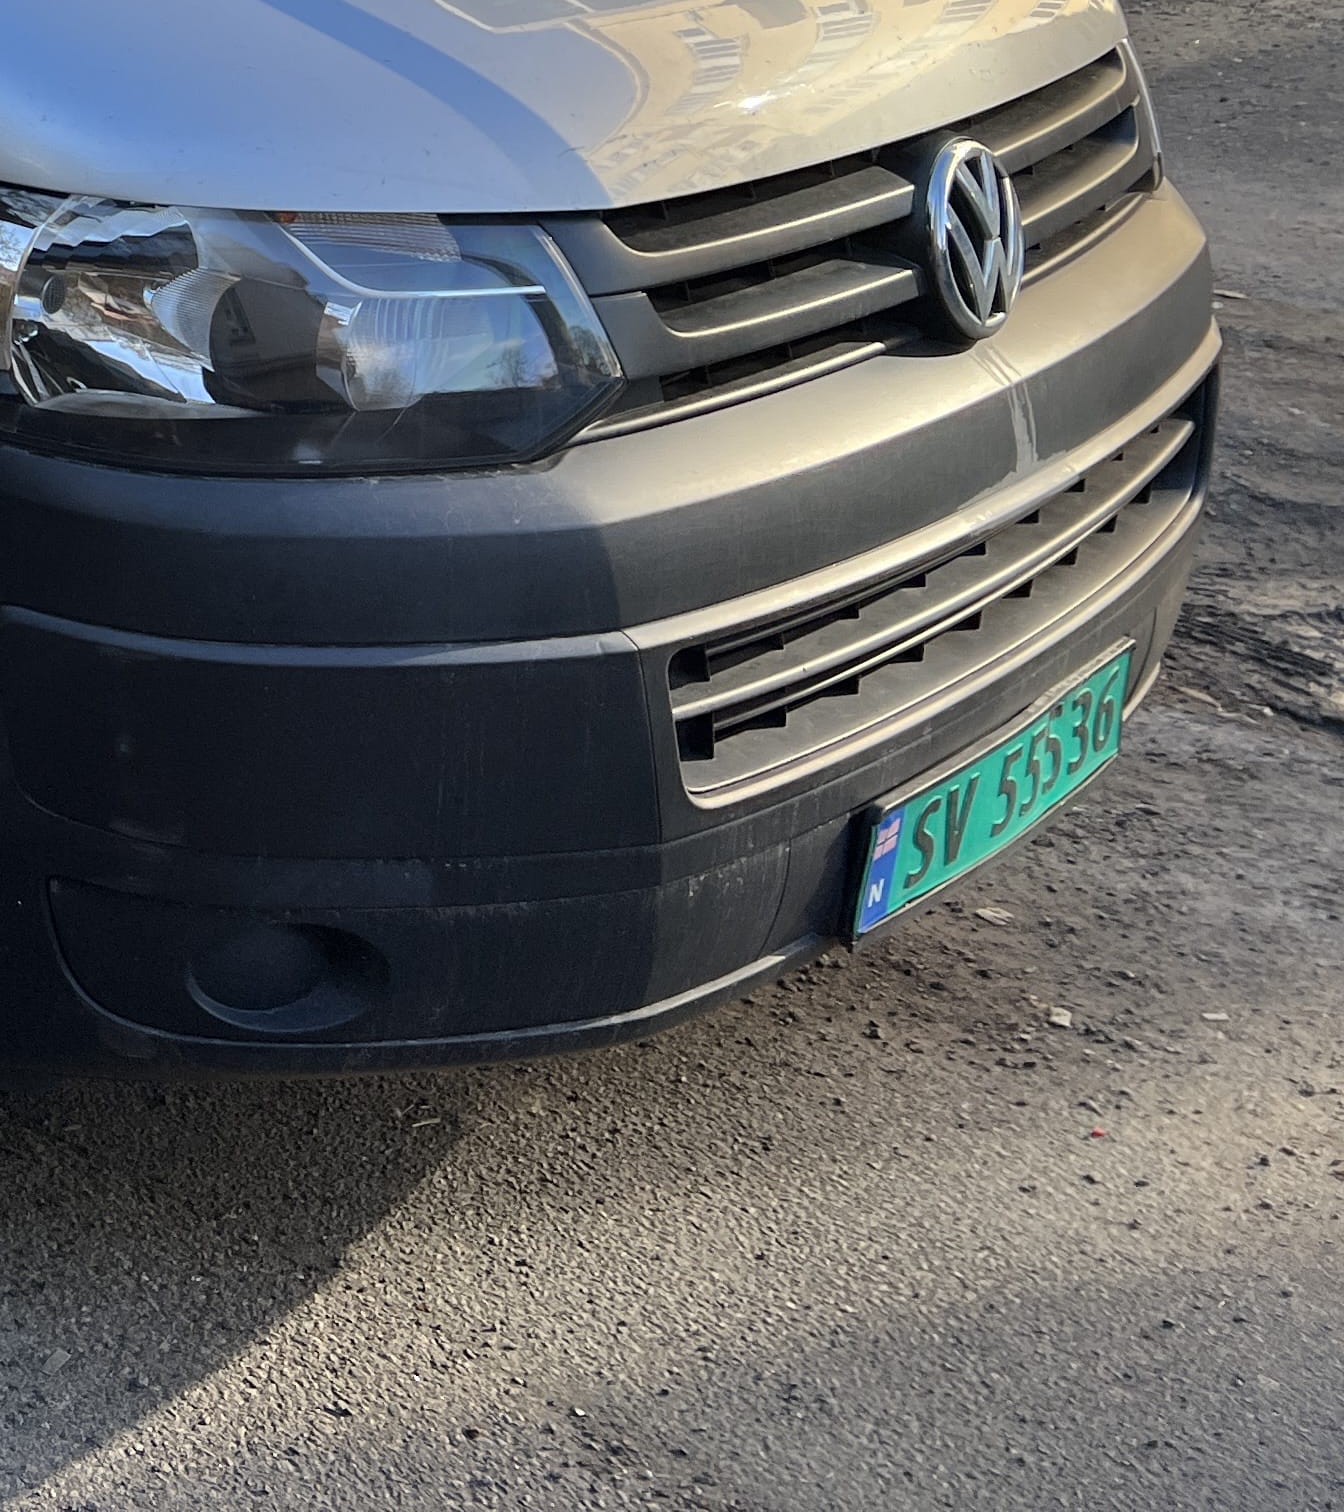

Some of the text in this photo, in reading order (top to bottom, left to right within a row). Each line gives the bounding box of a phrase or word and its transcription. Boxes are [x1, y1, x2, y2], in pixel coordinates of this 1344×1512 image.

[903, 665, 1120, 889] SV 55536
[867, 878, 884, 908] N
